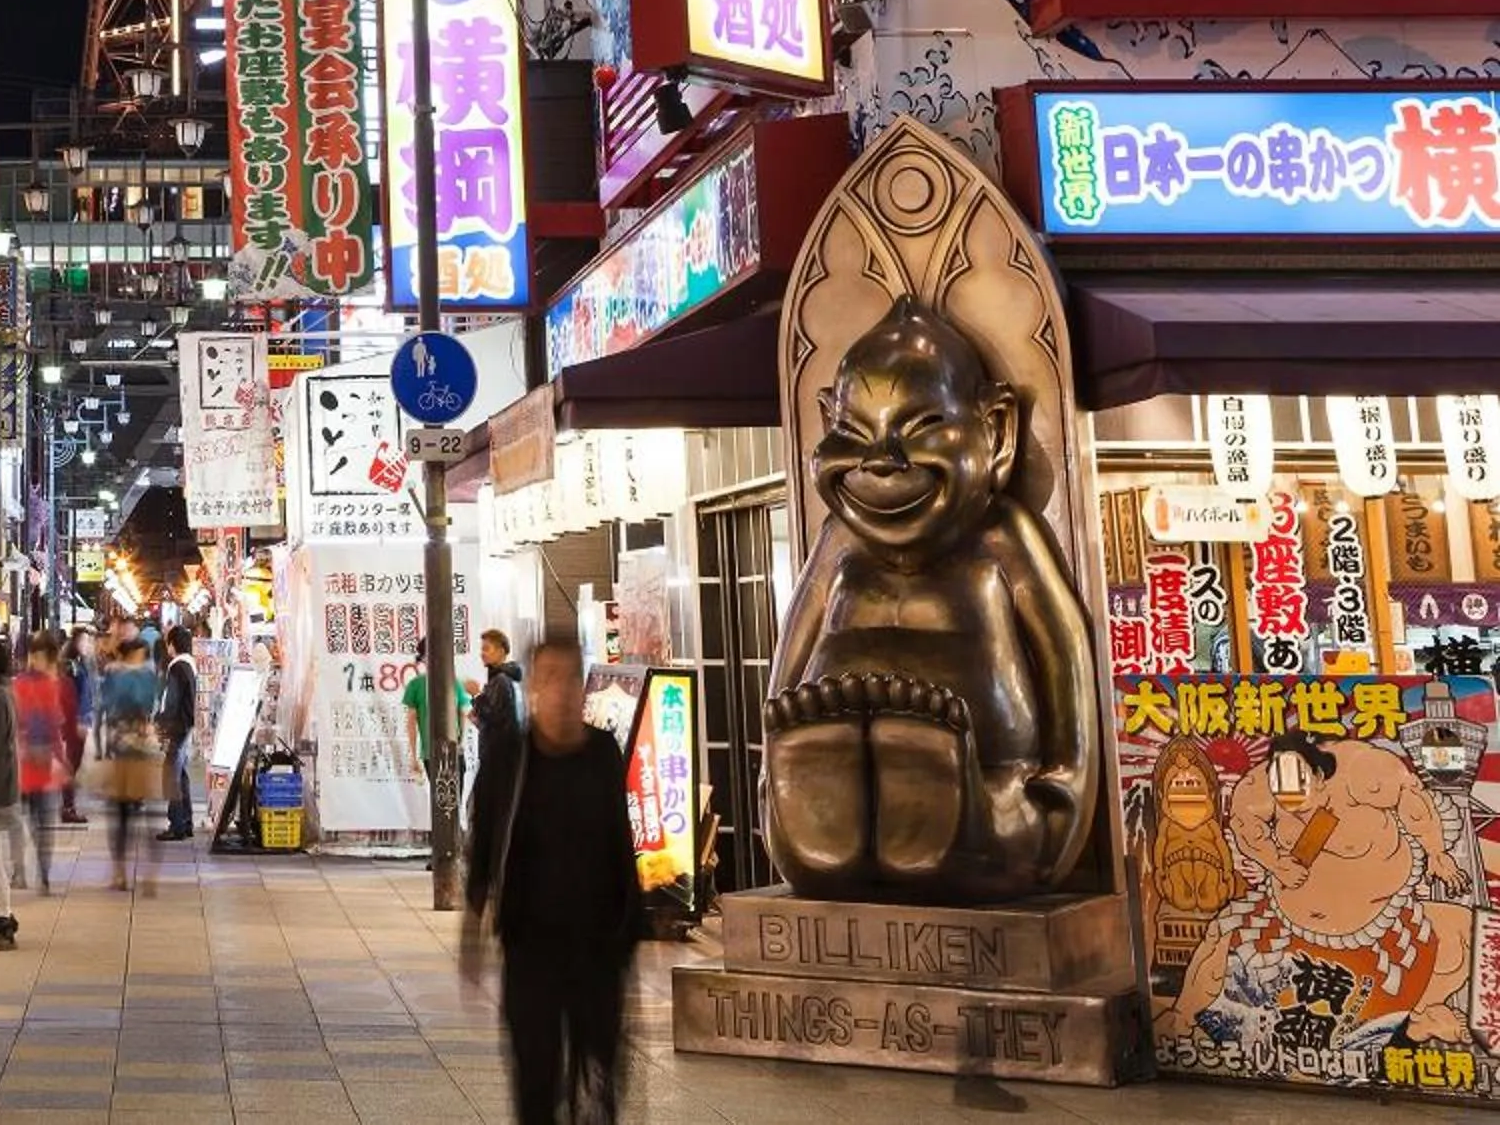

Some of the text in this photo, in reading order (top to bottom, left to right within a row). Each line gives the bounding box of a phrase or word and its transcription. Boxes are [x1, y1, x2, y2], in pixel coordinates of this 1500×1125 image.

[1055, 106, 1100, 219] 新世界
[1103, 128, 1386, 198] 日本一の串かつ
[1392, 104, 1500, 221] 横
[411, 436, 462, 455] 9-22
[1124, 681, 1408, 739] 大阪新世界
[758, 912, 1007, 976] BILLIKEN
[707, 987, 1069, 1066] THINGS-AS-THEY
